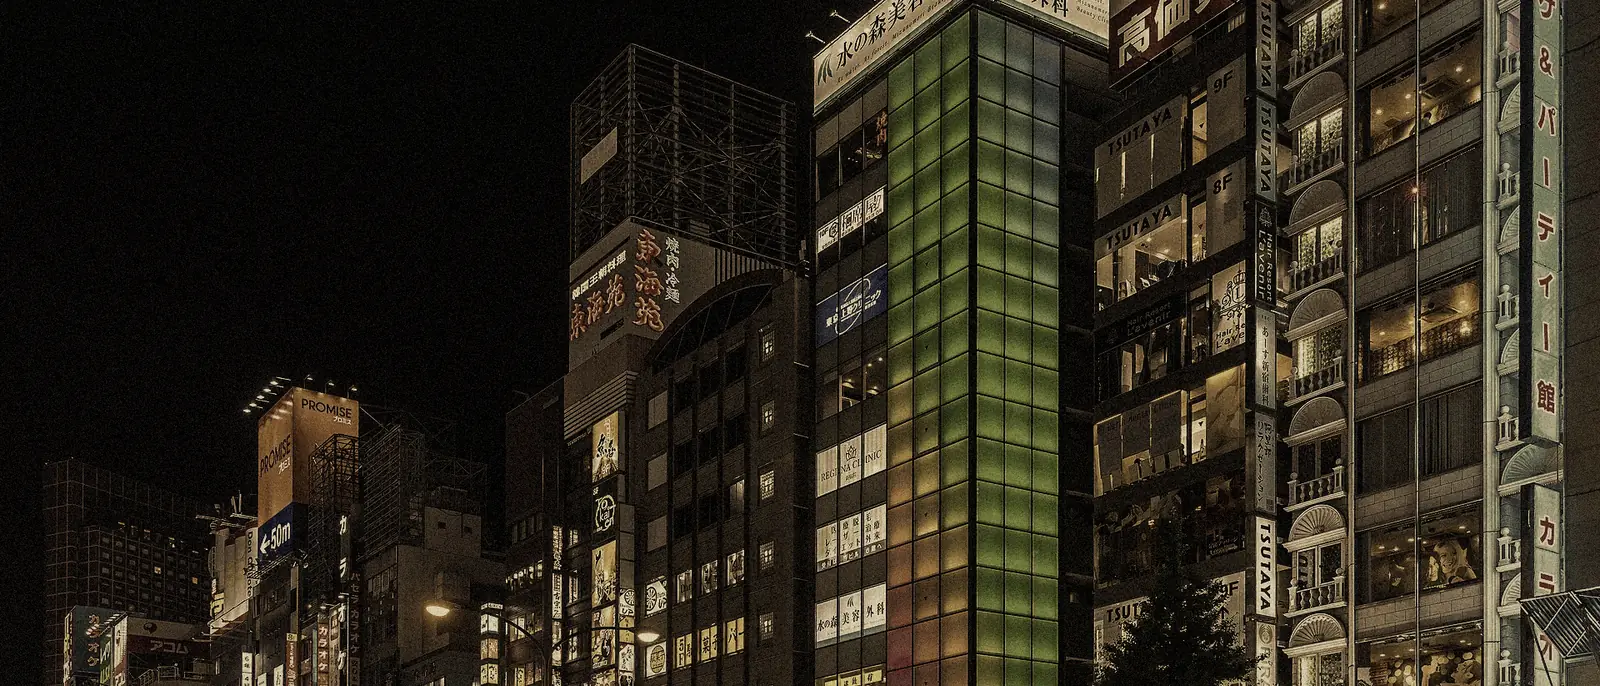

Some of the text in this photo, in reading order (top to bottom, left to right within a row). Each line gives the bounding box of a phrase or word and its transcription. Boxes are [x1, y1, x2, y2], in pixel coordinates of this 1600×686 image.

[1259, 3, 1272, 89] TSUTAYA
[1213, 69, 1234, 94] 9F
[1107, 106, 1173, 156] TSUTAYA
[1260, 105, 1272, 194] TSUTAYA
[1212, 172, 1233, 196] 8F
[1106, 203, 1172, 251] TSUTAYA
[632, 228, 665, 332] 東海苑
[1266, 261, 1274, 302] Resort
[301, 398, 352, 419] PROMISE
[260, 434, 291, 478] PROMISE
[270, 521, 291, 550] 50m
[1260, 523, 1272, 612] TSUTAYA
[817, 602, 885, 632] 水の森美容外科
[149, 639, 189, 655] アコム
[318, 626, 329, 672] カラオケ
